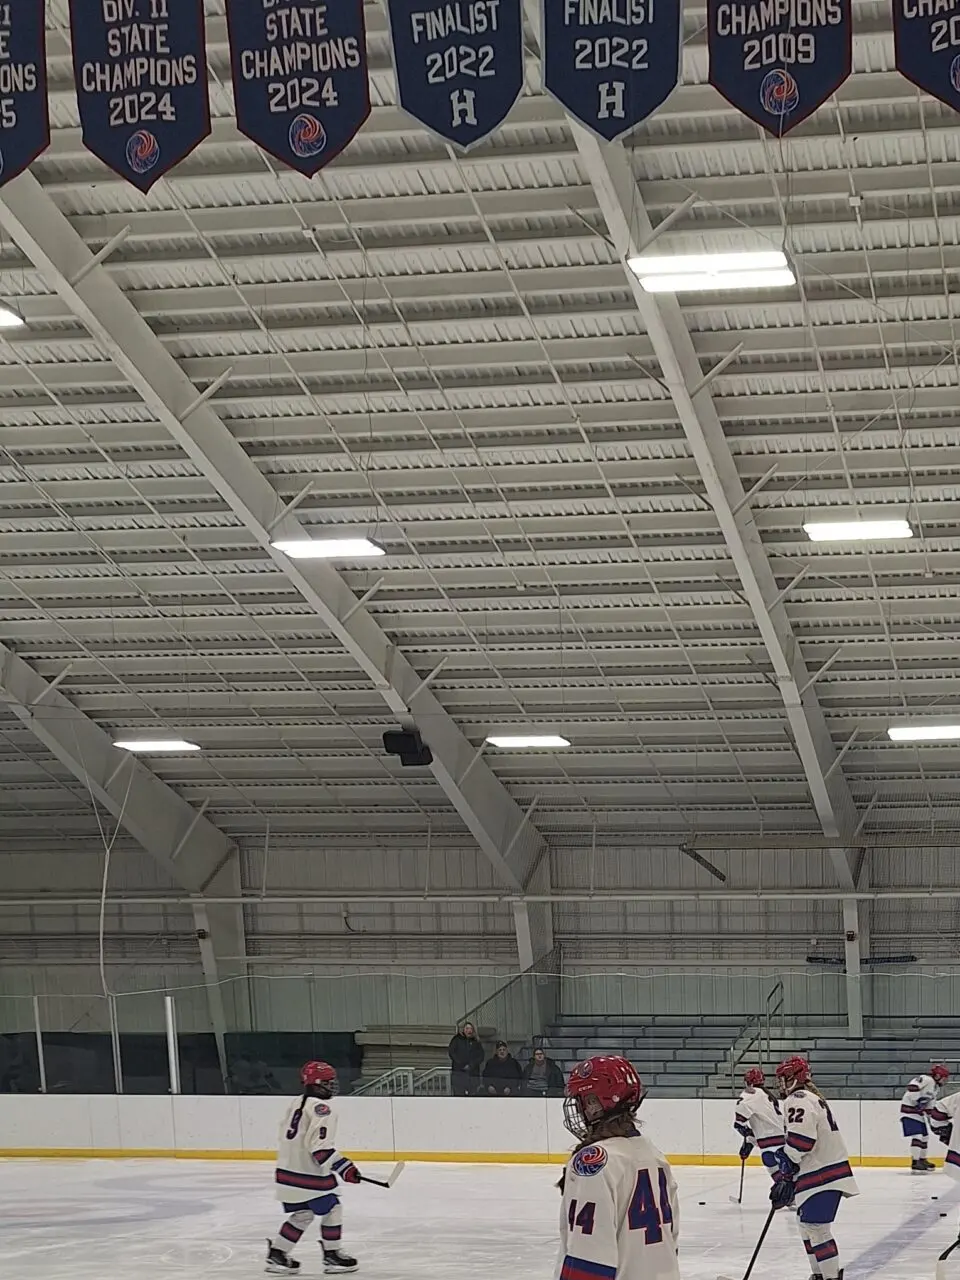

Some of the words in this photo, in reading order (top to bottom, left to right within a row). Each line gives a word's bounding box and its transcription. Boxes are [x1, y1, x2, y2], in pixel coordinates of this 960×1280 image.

[265, 5, 329, 42] STATE
[411, 0, 500, 44] FINALIST
[564, 0, 655, 26] FINALIST
[716, 0, 842, 37] CHAMPIONS
[107, 23, 171, 58] STATE
[241, 36, 361, 80] CHAMPIONS
[574, 36, 649, 71] 2022
[743, 32, 816, 71] 2009
[82, 54, 197, 93] CHAMPIONS
[426, 44, 496, 85] 2022
[109, 91, 177, 127] 2024
[267, 76, 339, 113] 2024
[450, 88, 478, 128] H
[597, 80, 626, 120] H
[286, 1109, 303, 1140] 9
[318, 1126, 328, 1140] 9
[787, 1107, 806, 1124] 22
